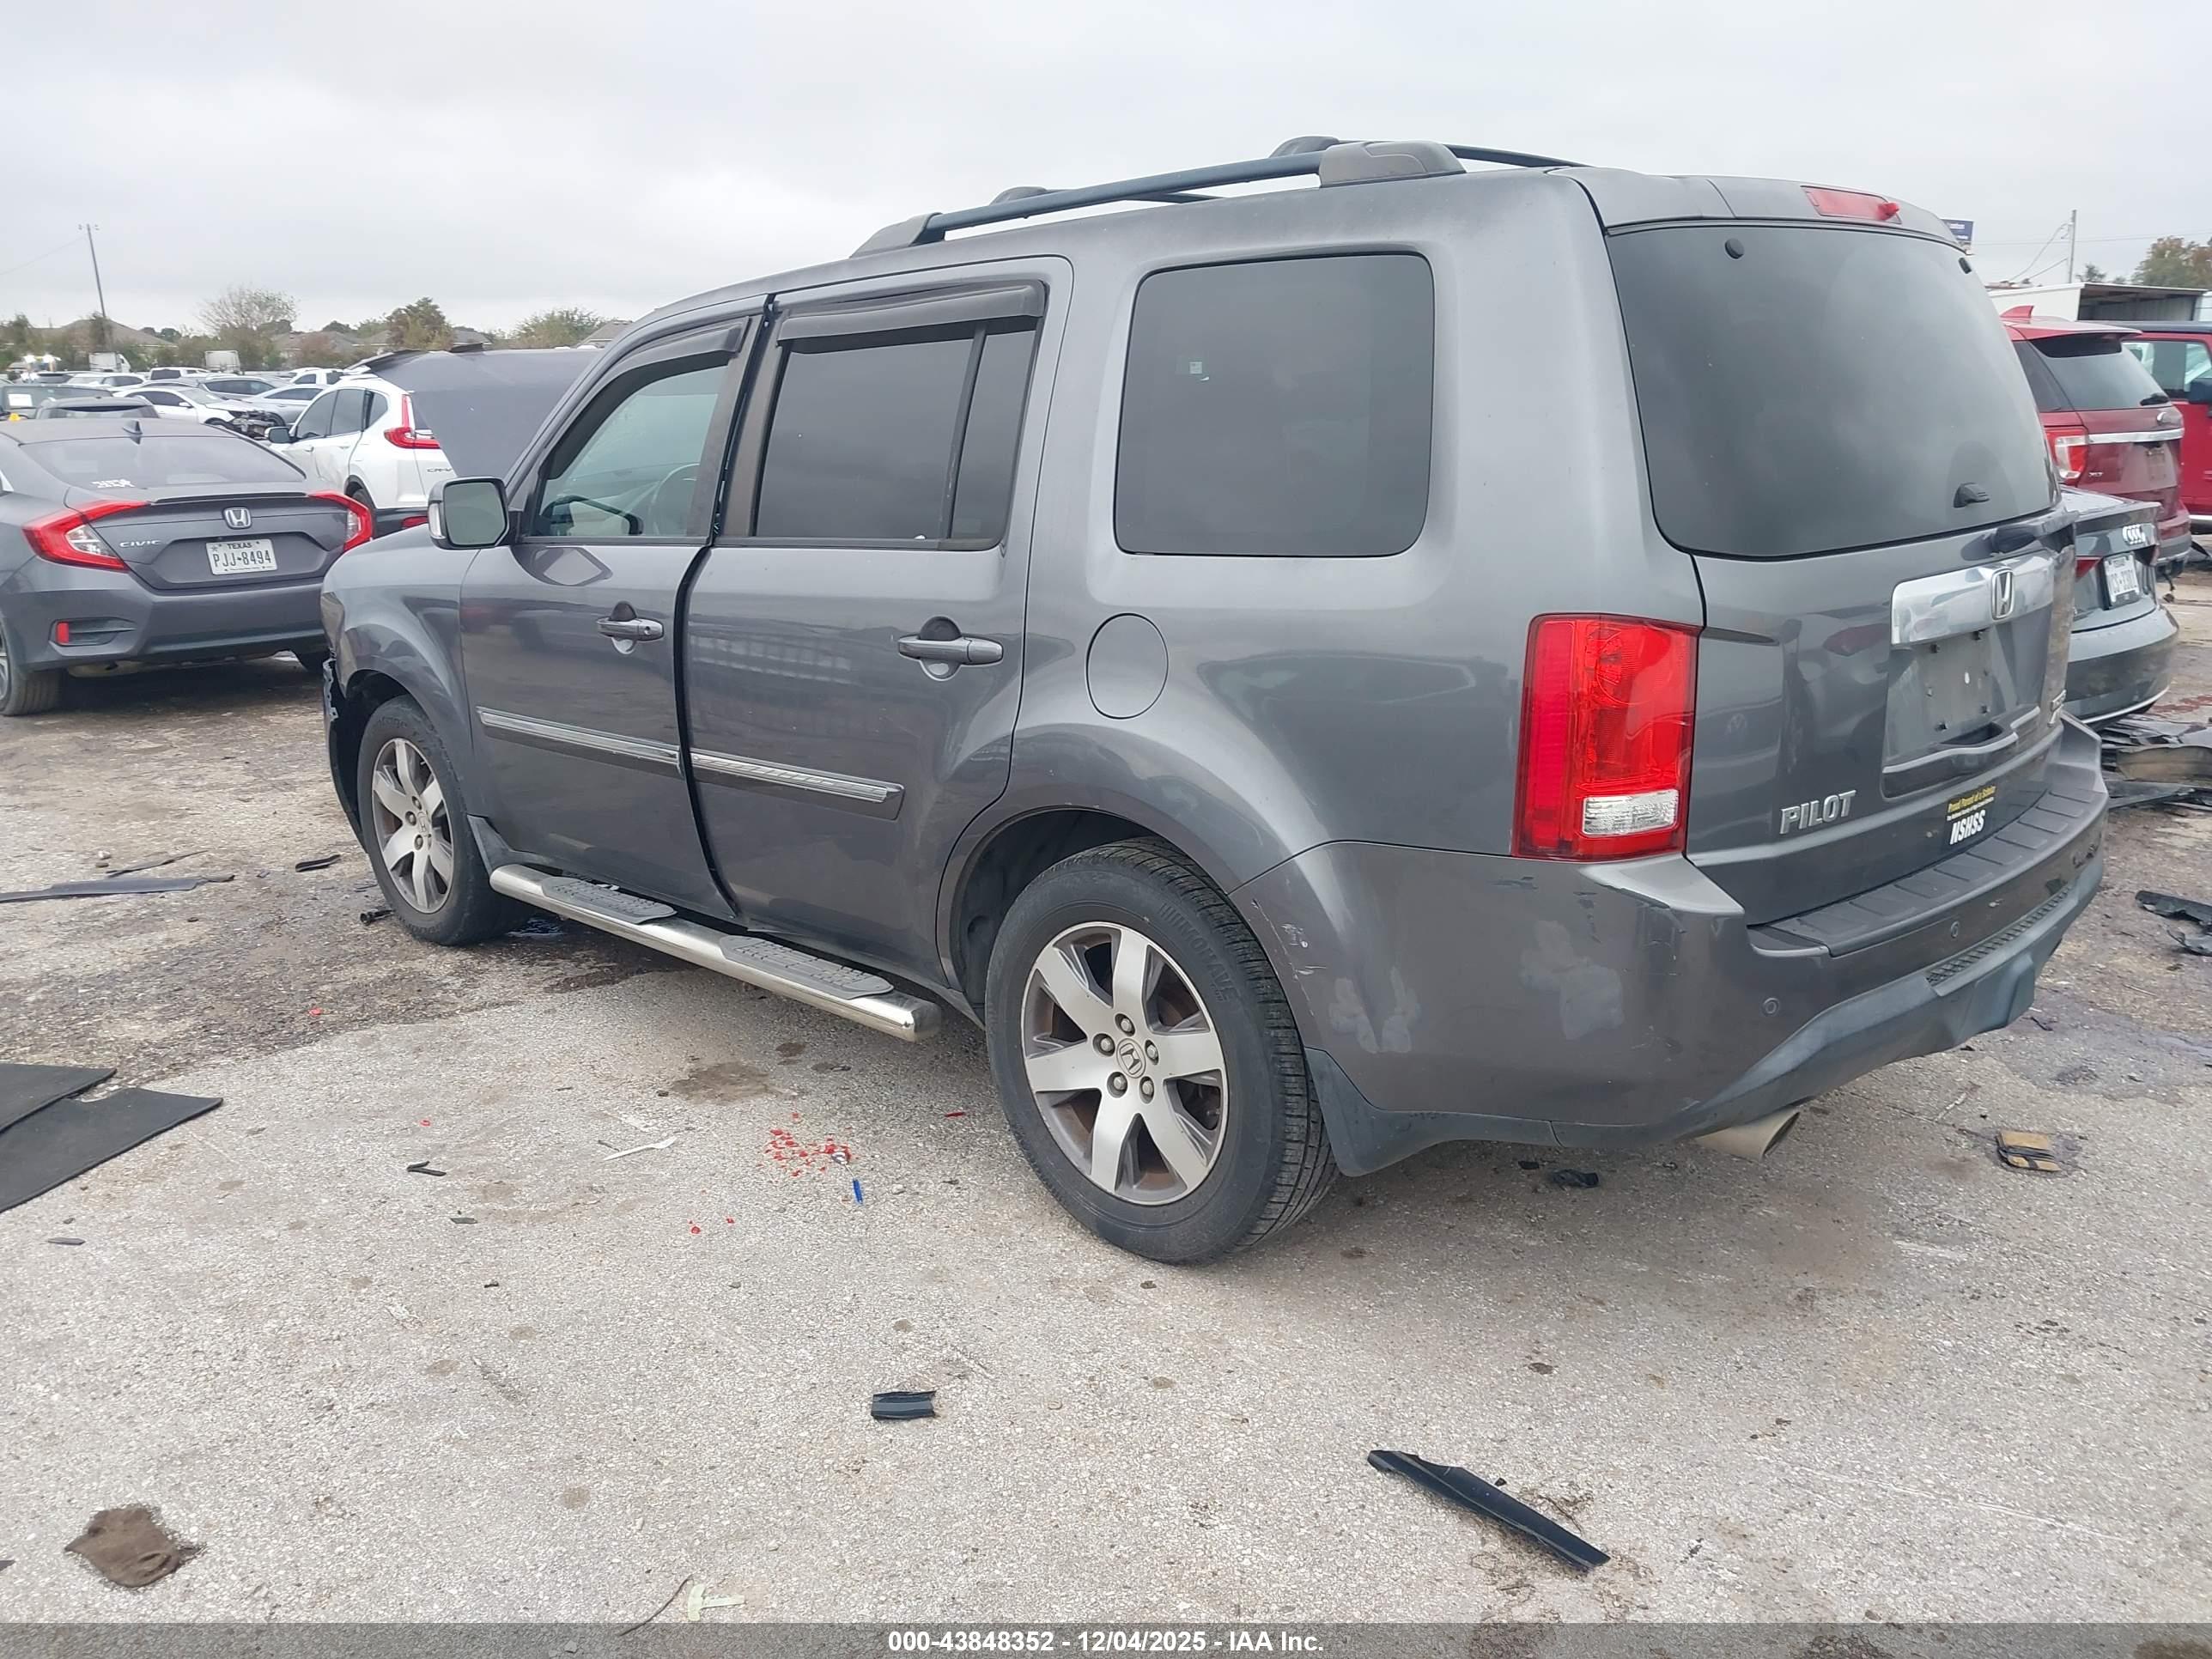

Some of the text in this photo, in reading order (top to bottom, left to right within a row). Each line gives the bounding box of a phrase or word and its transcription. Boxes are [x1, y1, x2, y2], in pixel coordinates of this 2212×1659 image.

[119, 539, 161, 548] CIVIC
[1779, 789, 1856, 835] PILOT
[1949, 809, 1985, 845] NSHSS
